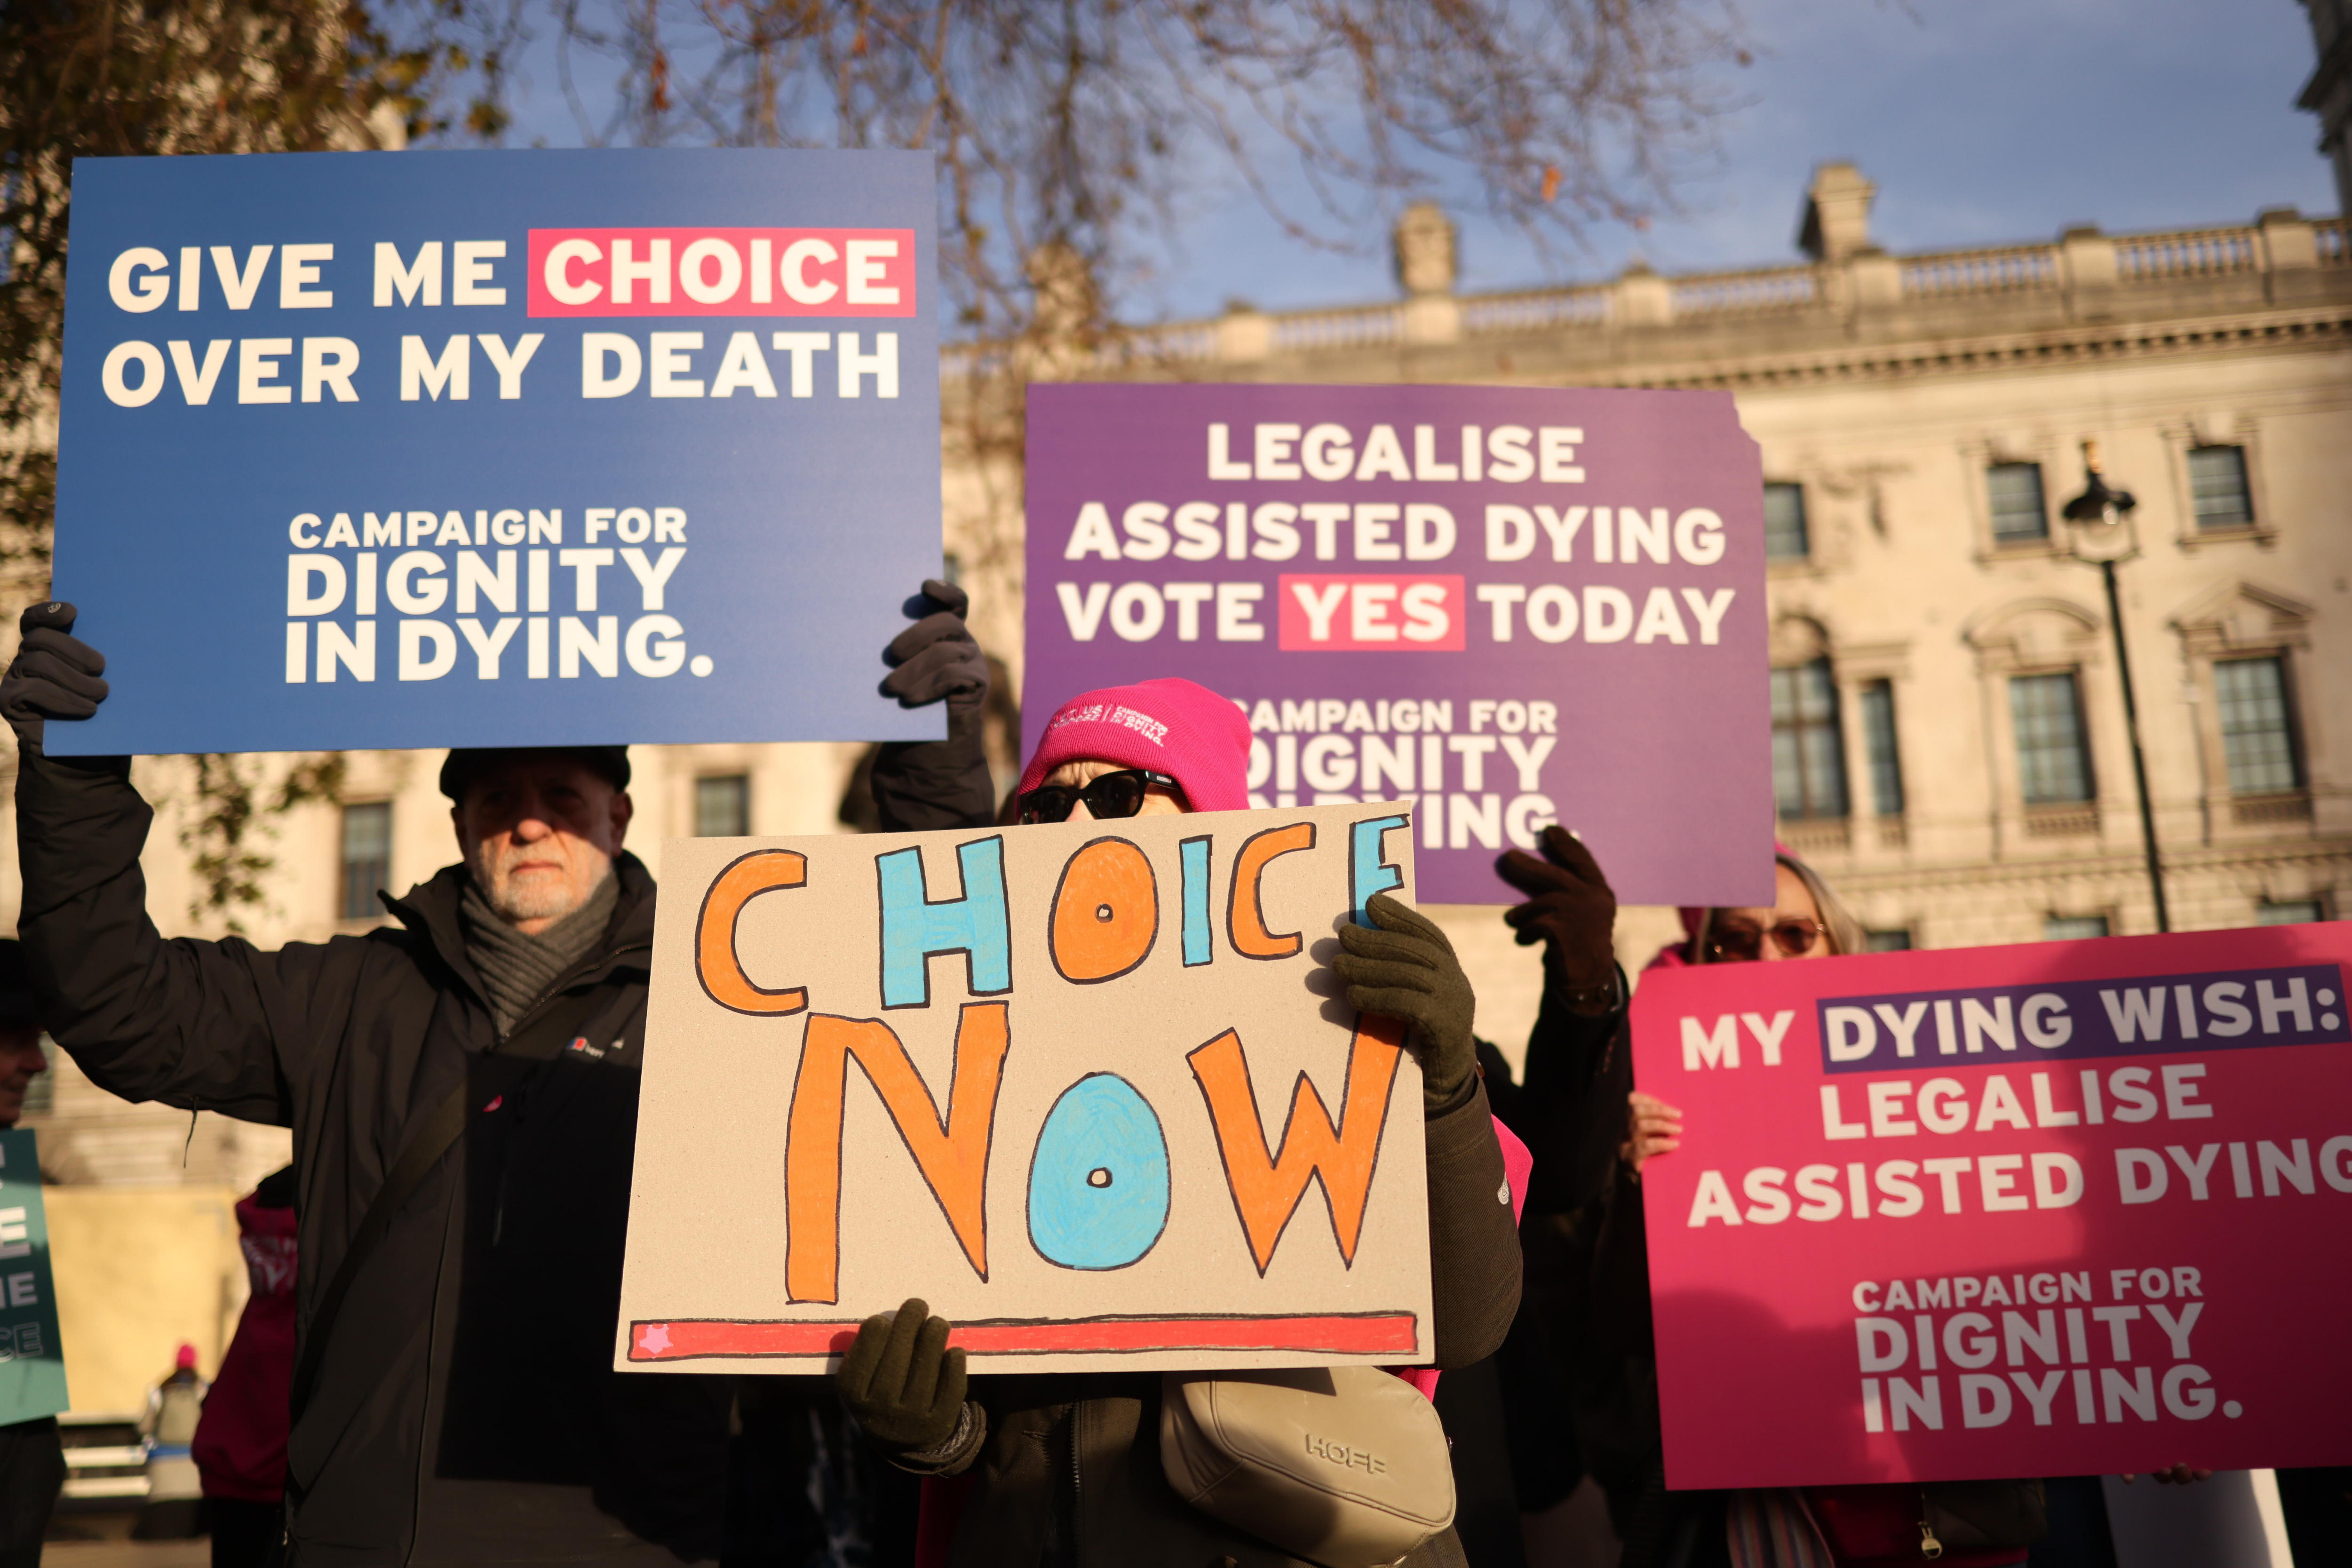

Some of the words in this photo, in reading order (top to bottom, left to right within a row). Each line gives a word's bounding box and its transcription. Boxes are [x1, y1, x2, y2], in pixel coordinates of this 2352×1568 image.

[109, 244, 334, 313] GIVE
[373, 241, 506, 307] ME
[544, 238, 900, 305] CHOICE
[101, 336, 360, 408] OVER
[400, 333, 546, 402] MY
[582, 331, 899, 399] DEATH
[1208, 423, 1586, 484] LEGALISE
[288, 508, 563, 549] CAMPAIGN
[585, 507, 688, 544] FOR
[1064, 501, 1457, 561] ASSISTED
[1486, 505, 1725, 565] DYING
[286, 546, 688, 617] DIGNITY
[1056, 581, 1264, 642] VOTE
[1292, 583, 1449, 641] YES
[1477, 584, 1735, 645] TODAY
[285, 620, 377, 684] IN
[398, 613, 715, 682] DYING.
[1113, 712, 1166, 737] DIGNITY
[1117, 706, 1154, 724] CAMPAIGN
[1154, 721, 1168, 732] FOR
[1124, 722, 1164, 748] DYING.
[1231, 699, 1453, 733] AMPAIGN
[1469, 700, 1557, 734] FOR
[695, 813, 1410, 1016] CHOICE
[1680, 1010, 1796, 1071] MY
[1824, 993, 2072, 1062] DYING
[2098, 977, 2340, 1043] WISH:
[1819, 1064, 2212, 1141] LEGALISE
[784, 1000, 1409, 1305] NOW
[1687, 1152, 2083, 1228] ASSISTED
[2114, 1135, 2352, 1205] DYING
[1852, 1271, 2092, 1313] CAMPAIGN
[2110, 1266, 2203, 1301] FOR
[1854, 1302, 2204, 1373] DIGNITY
[1861, 1375, 1944, 1433] IN
[1958, 1363, 2243, 1429] DYING.
[1305, 1433, 1387, 1475] HOFF
